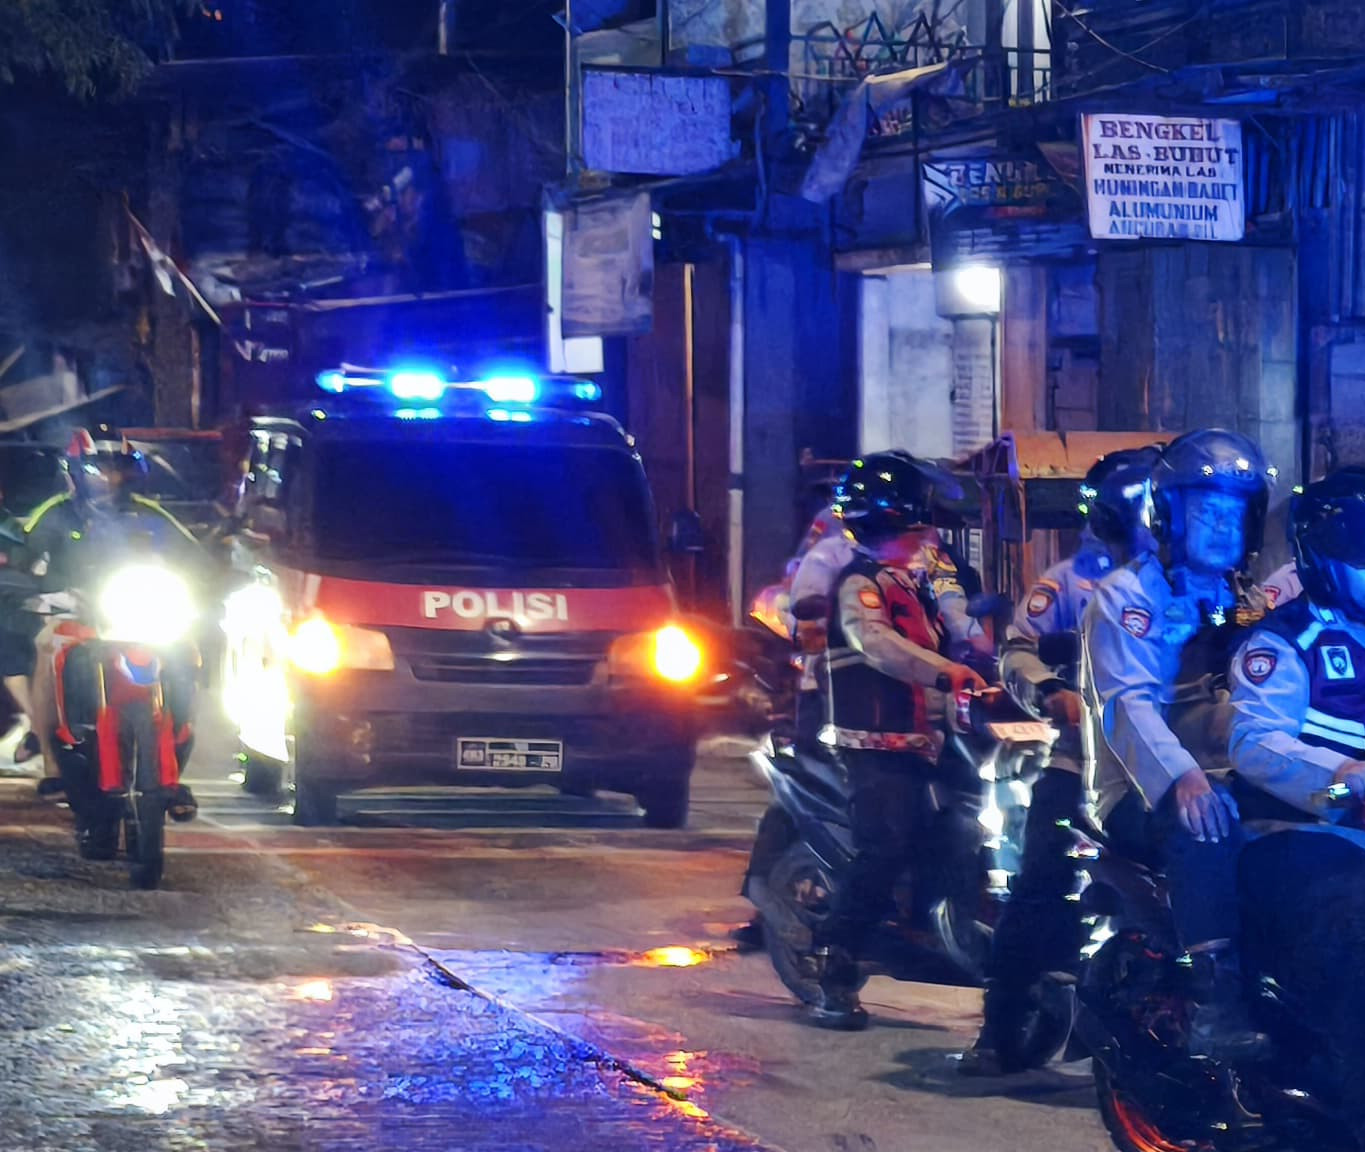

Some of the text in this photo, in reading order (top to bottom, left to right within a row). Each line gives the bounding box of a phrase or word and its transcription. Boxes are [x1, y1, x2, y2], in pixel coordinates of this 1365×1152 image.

[1099, 120, 1220, 142] BENGKEL
[1092, 143, 1142, 160] LAS
[1109, 200, 1218, 221] ALUMUNIUM
[423, 589, 568, 621] POLISI
